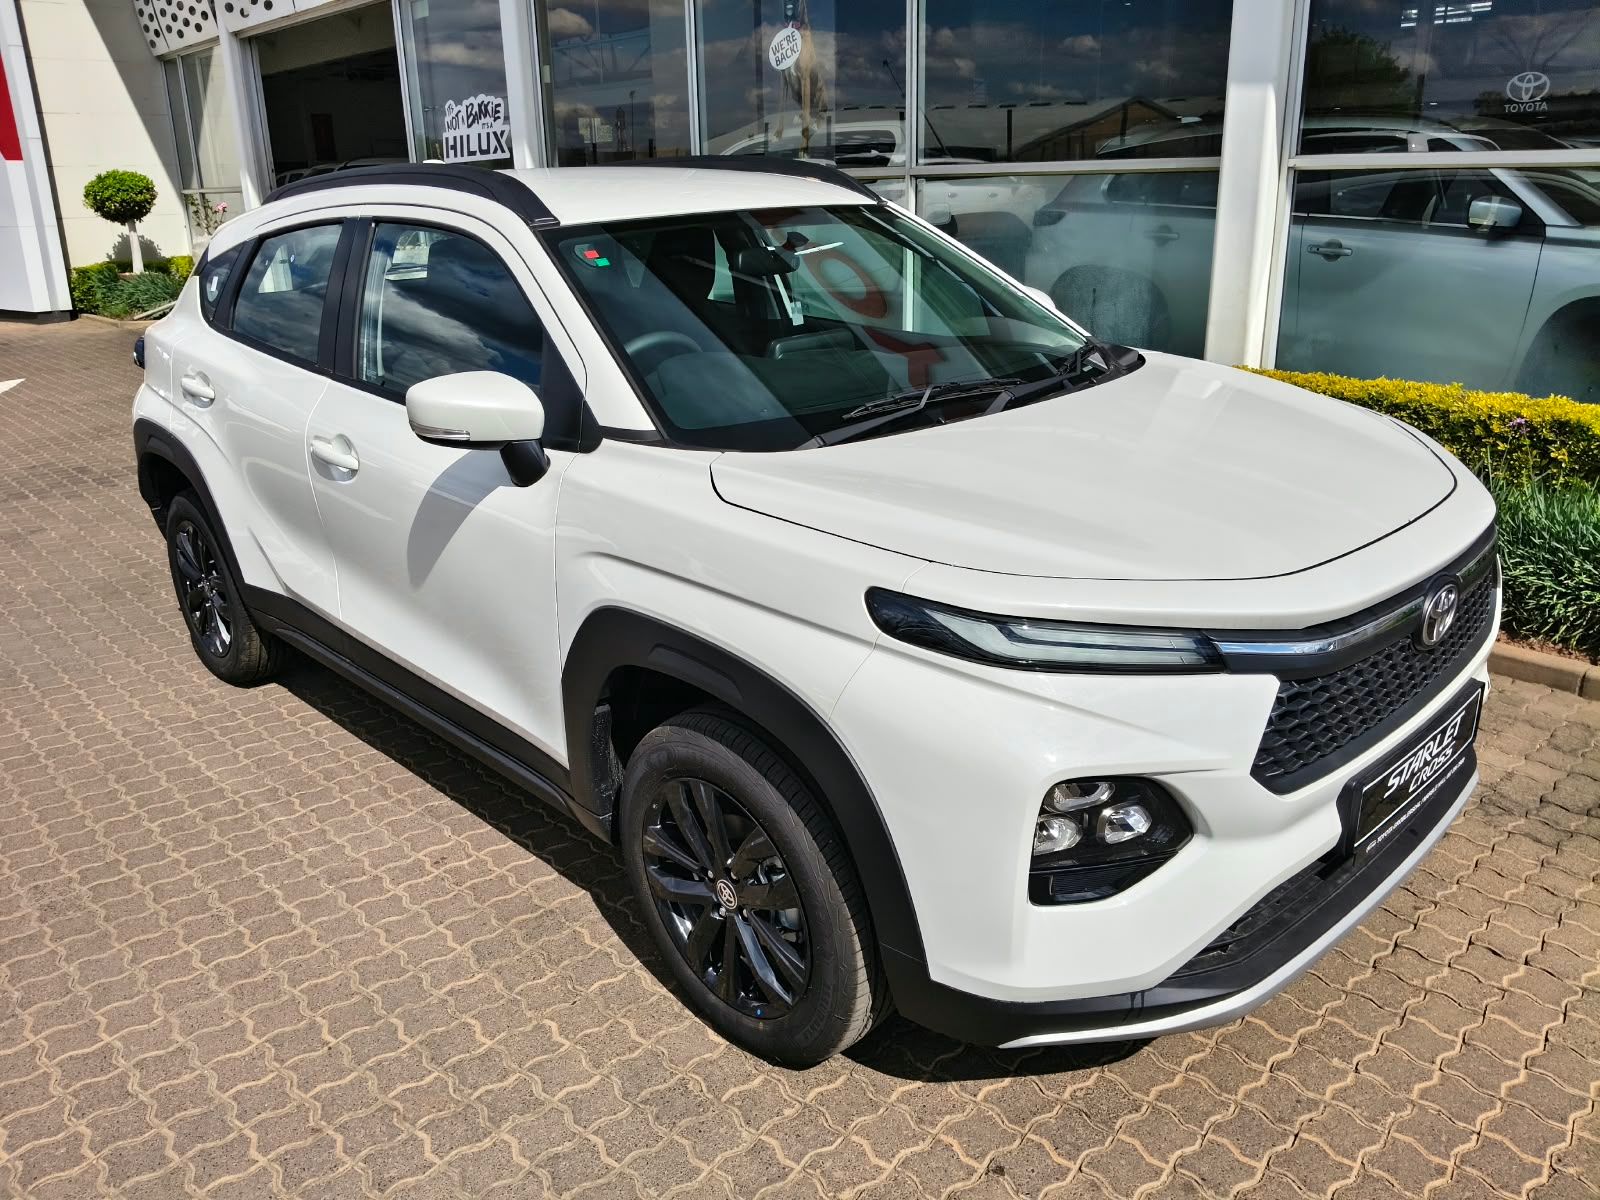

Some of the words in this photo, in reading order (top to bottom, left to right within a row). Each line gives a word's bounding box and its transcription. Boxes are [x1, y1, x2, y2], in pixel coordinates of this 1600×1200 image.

[771, 30, 797, 56] WE'RE
[775, 42, 799, 67] BACK!
[1504, 101, 1548, 112] TOYOTA
[446, 110, 461, 132] NOT
[445, 130, 506, 158] HILUX
[1384, 710, 1466, 799] STARLET
[1409, 740, 1456, 793] CROSS
